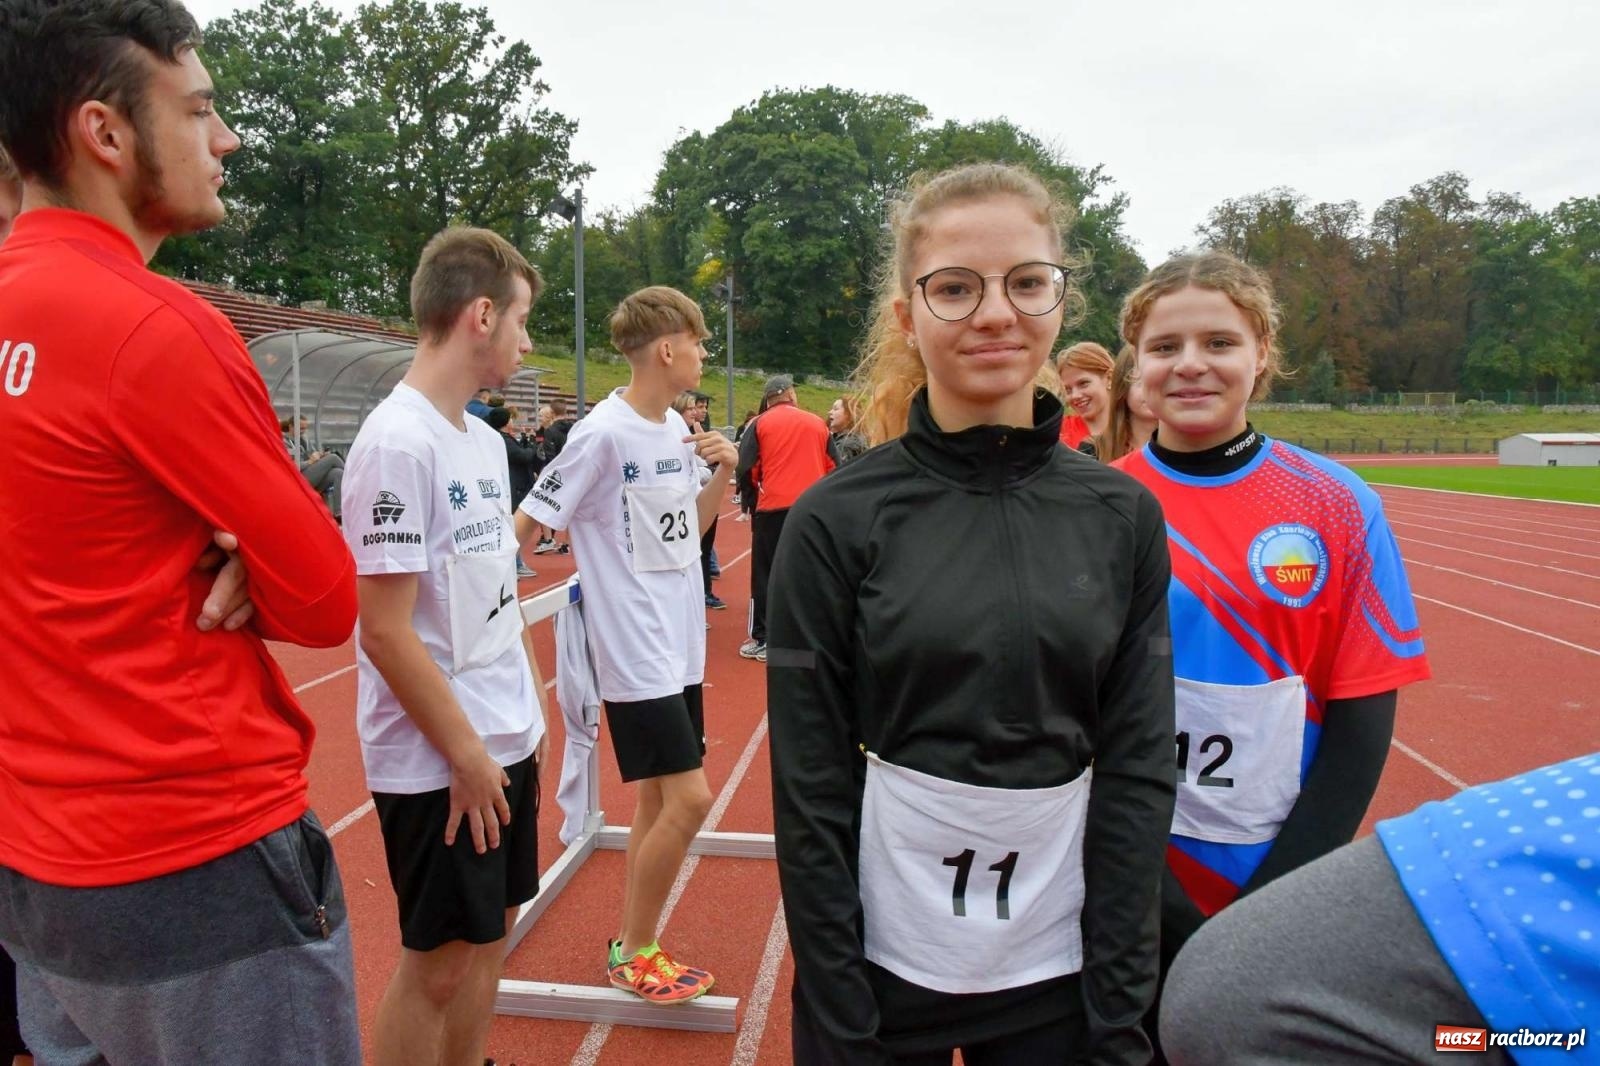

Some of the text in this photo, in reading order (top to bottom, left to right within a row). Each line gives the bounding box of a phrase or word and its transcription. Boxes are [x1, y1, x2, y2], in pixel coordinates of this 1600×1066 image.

[362, 532, 421, 547] BOGDANKA
[453, 522, 484, 544] WORLD
[659, 510, 689, 542] 23
[1276, 566, 1313, 583] ŚWIT
[1176, 731, 1234, 788] 12
[941, 848, 1019, 920] 11
